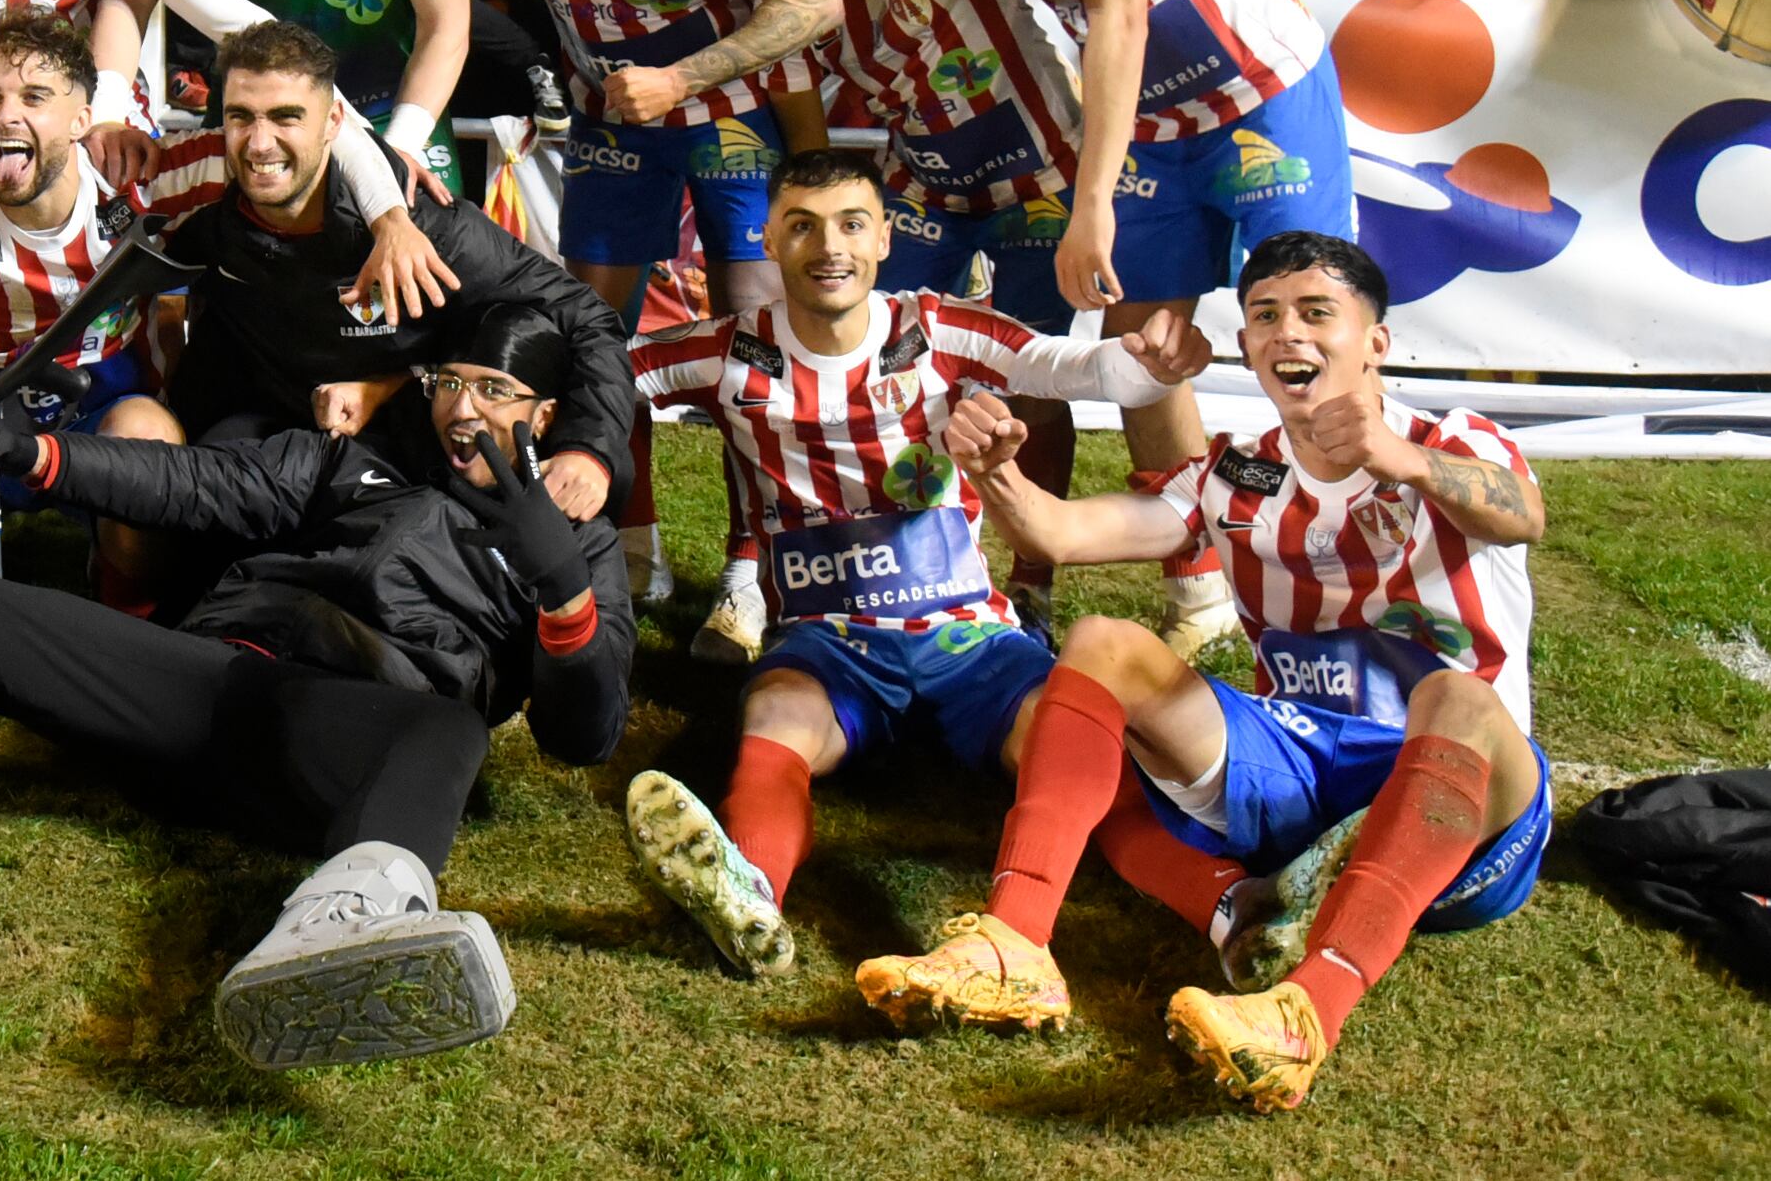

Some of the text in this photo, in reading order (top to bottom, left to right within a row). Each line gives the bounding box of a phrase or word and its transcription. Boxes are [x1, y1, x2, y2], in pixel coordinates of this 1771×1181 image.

[1139, 54, 1221, 102] ADERÍAS
[563, 140, 641, 172] oacsa
[696, 171, 772, 181] BARBASTR
[734, 339, 783, 367] Huesca
[879, 331, 923, 367] Huesca
[1222, 458, 1282, 486] Huesca
[781, 541, 901, 590] Berta
[842, 577, 979, 611] PESCADERÍAS
[1272, 651, 1354, 696] Berta
